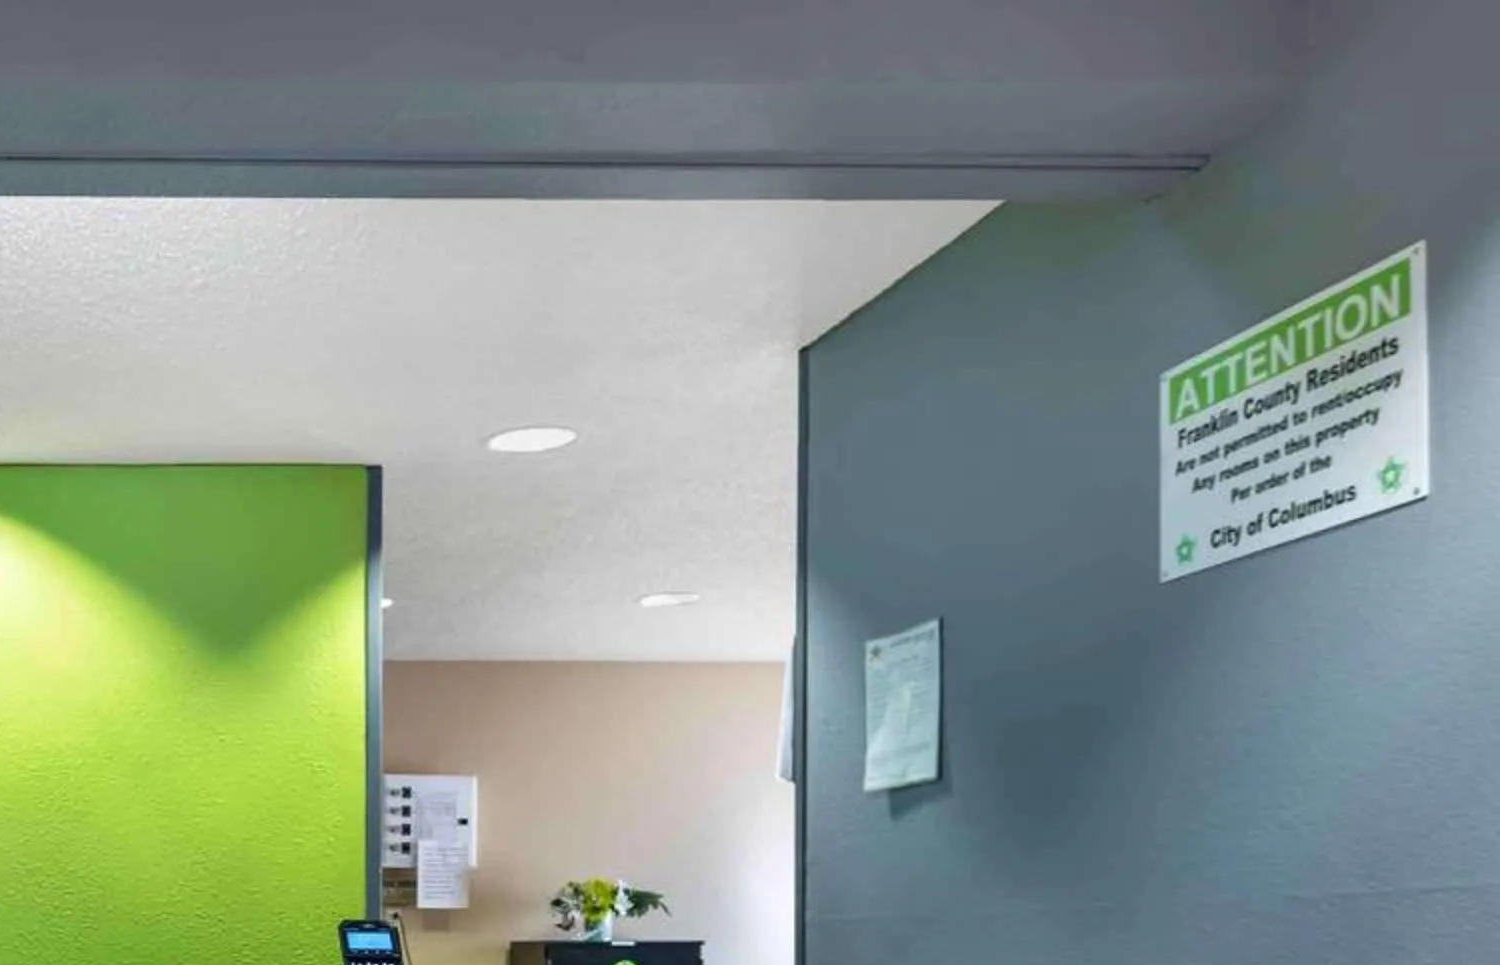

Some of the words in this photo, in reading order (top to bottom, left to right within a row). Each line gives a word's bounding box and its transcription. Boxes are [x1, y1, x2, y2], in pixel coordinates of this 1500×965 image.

[1175, 274, 1400, 420] ATTENTION
[1178, 408, 1238, 448] Franklin
[1244, 380, 1300, 419] County
[1306, 337, 1399, 392] Residents
[1176, 458, 1196, 476] Are
[1199, 445, 1220, 464] not
[1223, 414, 1289, 459] permitted
[1293, 410, 1307, 426] to
[1192, 474, 1216, 493] Any
[1219, 457, 1259, 482] rooms
[1263, 448, 1280, 464] on
[1284, 435, 1310, 455] this
[1315, 407, 1380, 448] property
[1230, 486, 1252, 504] Per
[1255, 472, 1290, 494] order
[1293, 461, 1306, 480] of
[1309, 455, 1332, 473] the
[1210, 525, 1242, 548] City
[1246, 513, 1263, 536] of
[1268, 485, 1357, 528] Columbus
